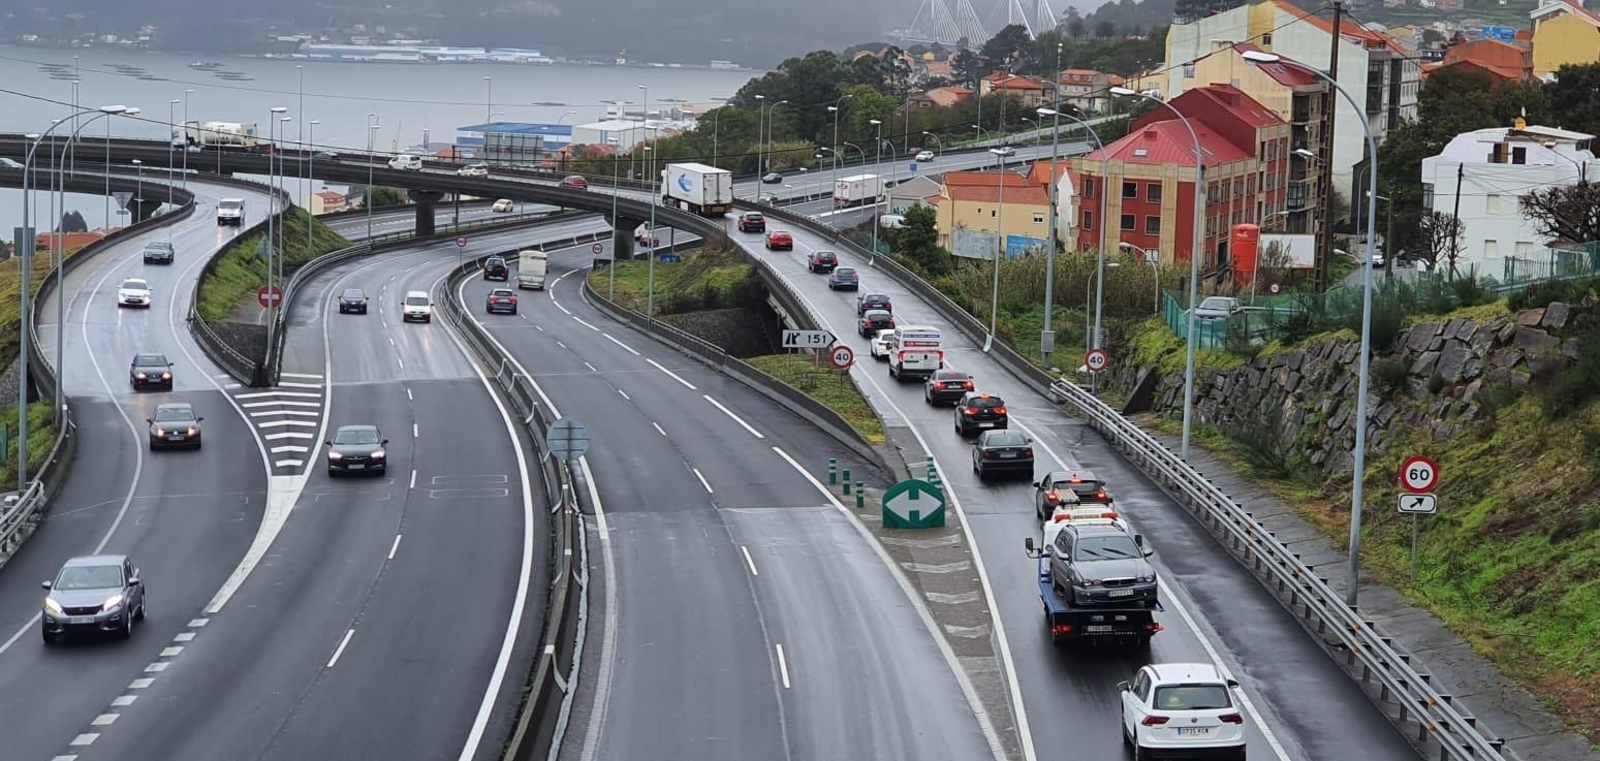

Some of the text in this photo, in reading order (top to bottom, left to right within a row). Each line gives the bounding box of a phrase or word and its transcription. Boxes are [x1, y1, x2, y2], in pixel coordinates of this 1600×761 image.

[807, 334, 826, 344] 151
[835, 353, 849, 361] 40
[1090, 356, 1104, 364] 40
[1410, 468, 1430, 481] 60
